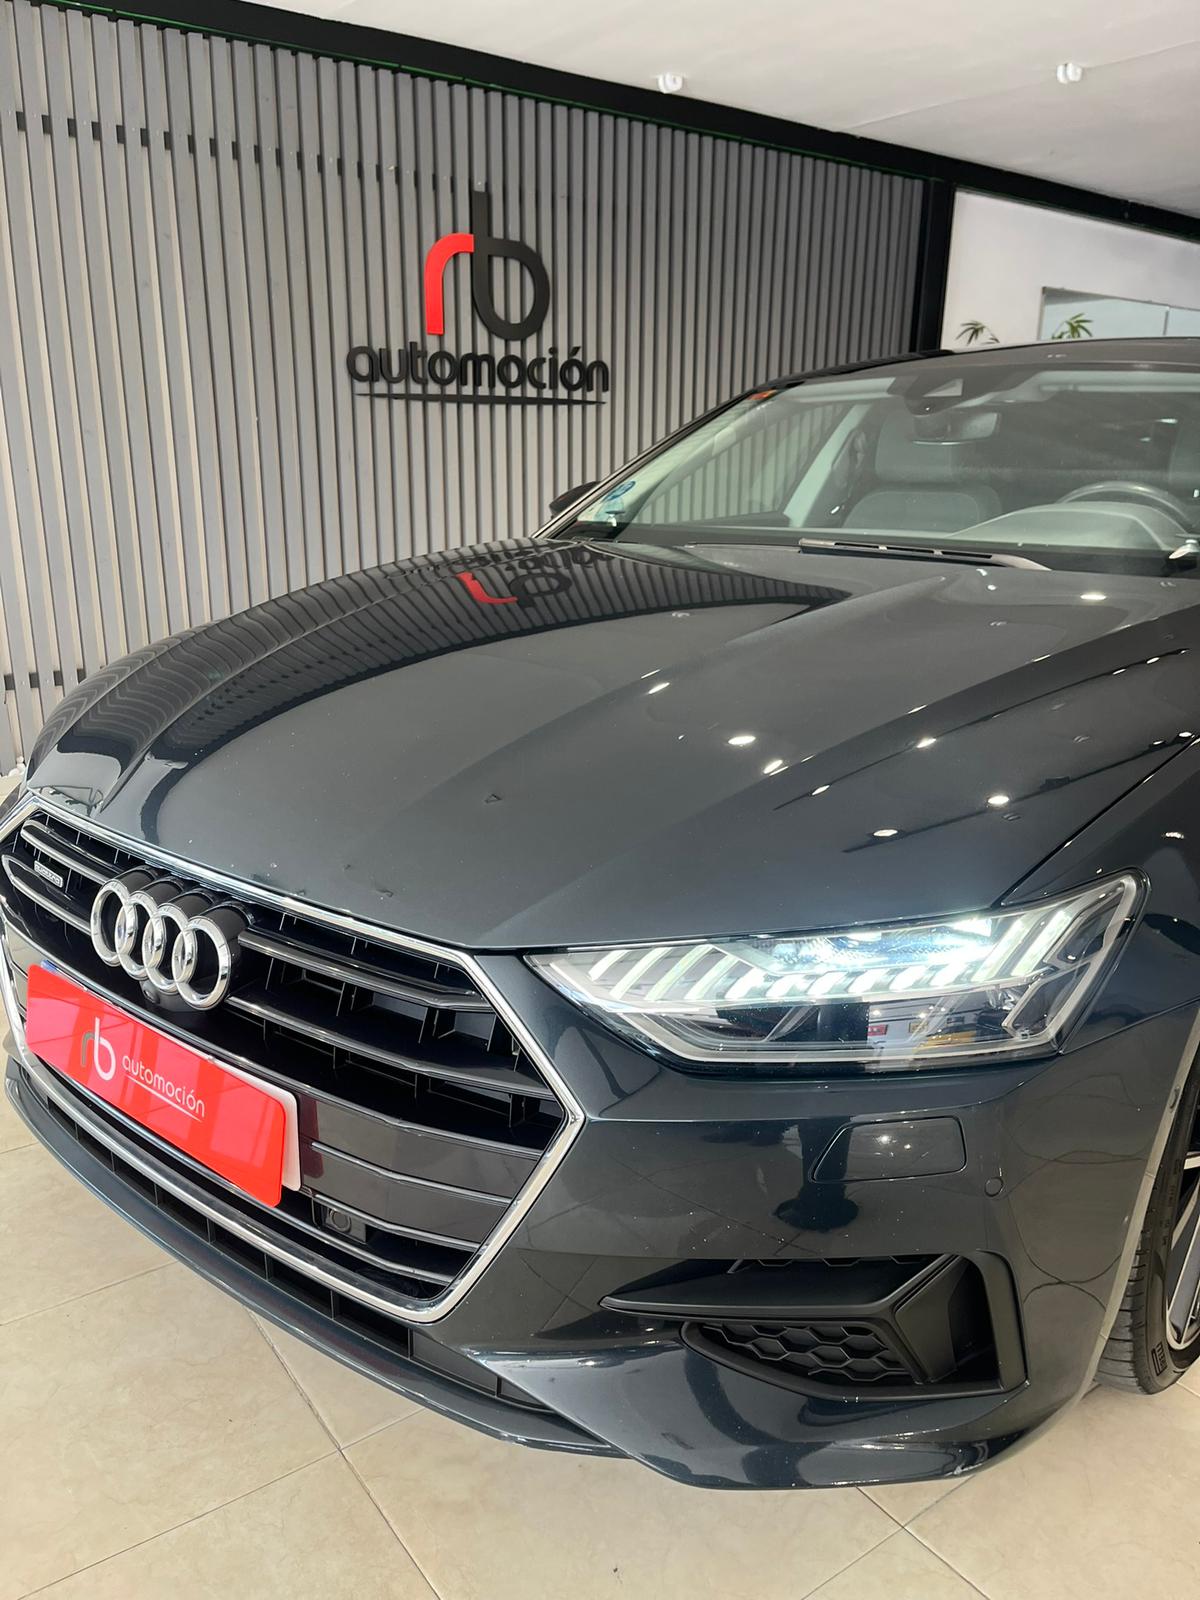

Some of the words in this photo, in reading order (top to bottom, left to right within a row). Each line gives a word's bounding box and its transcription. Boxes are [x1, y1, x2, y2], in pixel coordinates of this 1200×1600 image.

[424, 190, 550, 341] rb
[346, 341, 609, 392] automoción
[81, 1017, 116, 1081] rb
[122, 1055, 205, 1118] automoción
